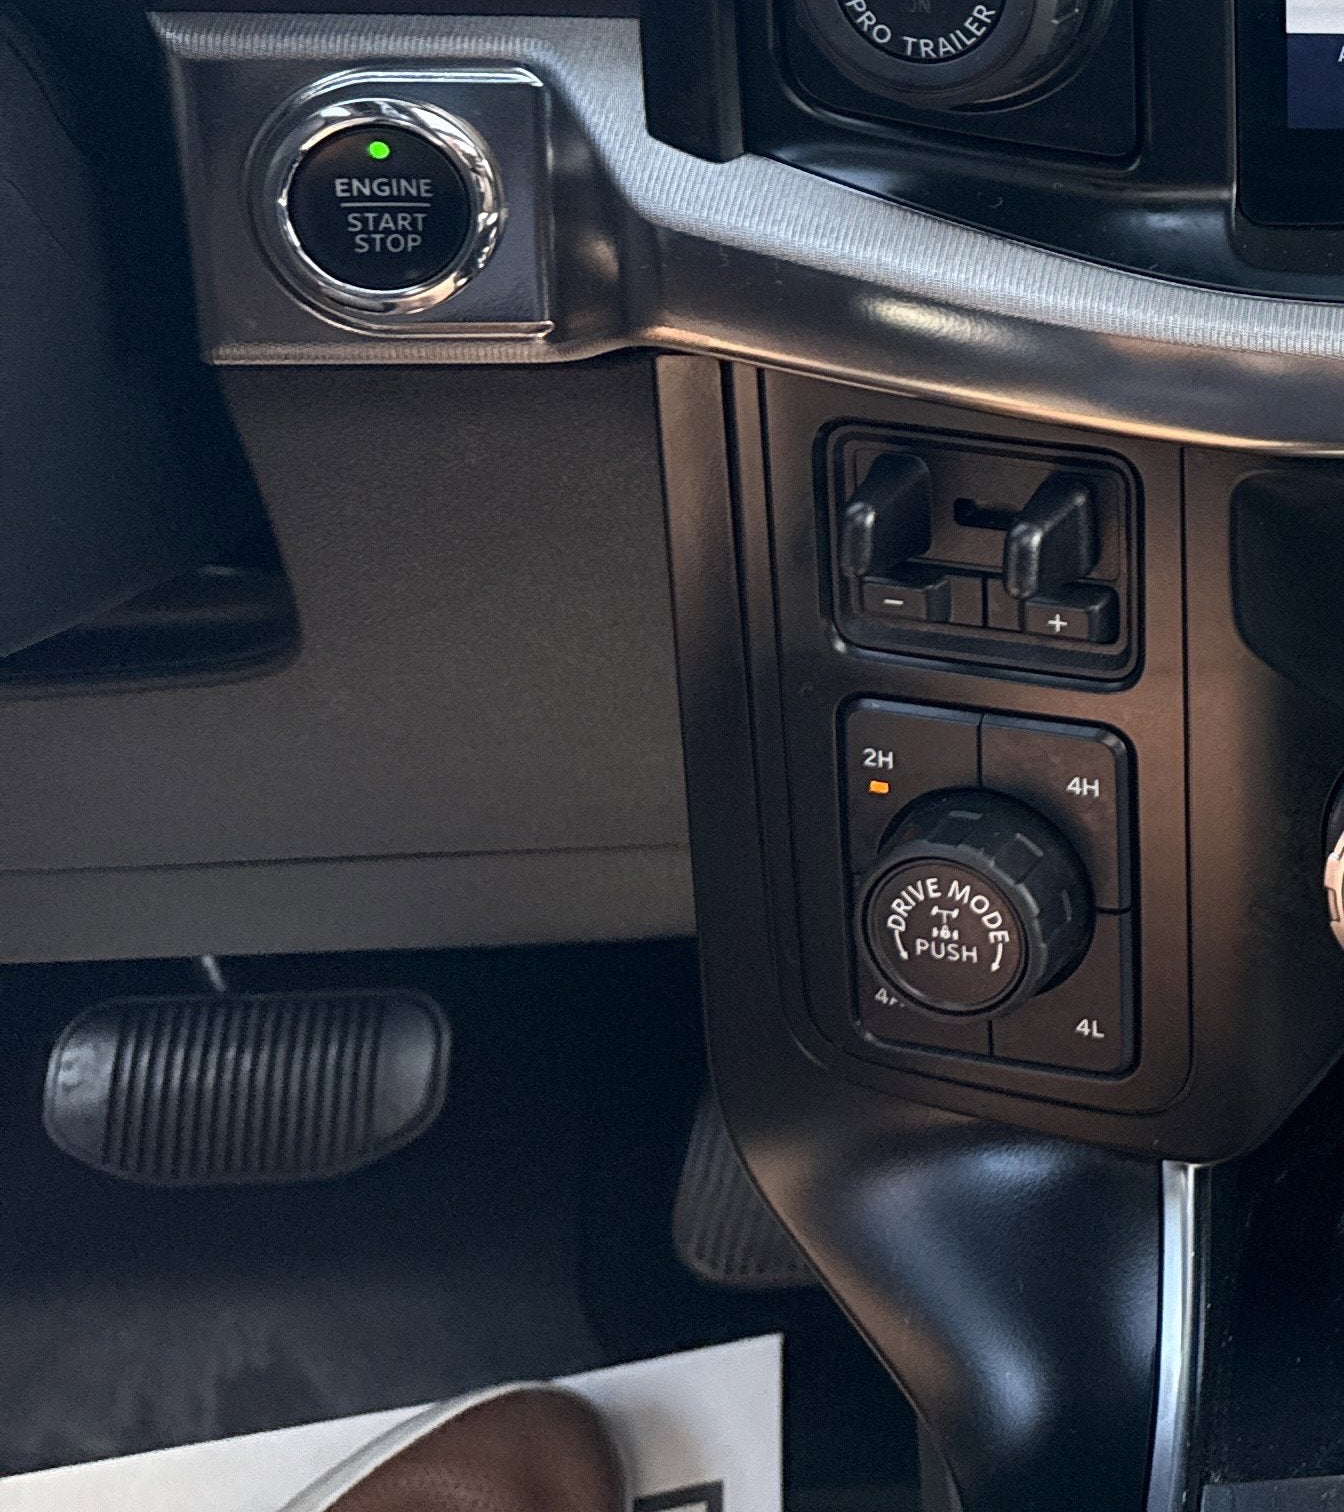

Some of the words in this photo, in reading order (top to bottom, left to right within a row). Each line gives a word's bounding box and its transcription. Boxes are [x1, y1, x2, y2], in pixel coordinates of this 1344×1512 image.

[903, 4, 996, 58] TRAILER
[334, 178, 433, 198] ENGINE
[347, 213, 428, 231] START
[354, 234, 422, 253] STOP
[862, 748, 894, 769] 2H
[1066, 777, 1099, 798] 4H
[887, 877, 942, 932] DRIVE
[948, 879, 1010, 945] MODE
[916, 938, 978, 963] PUSH
[1075, 1018, 1105, 1038] 4L
